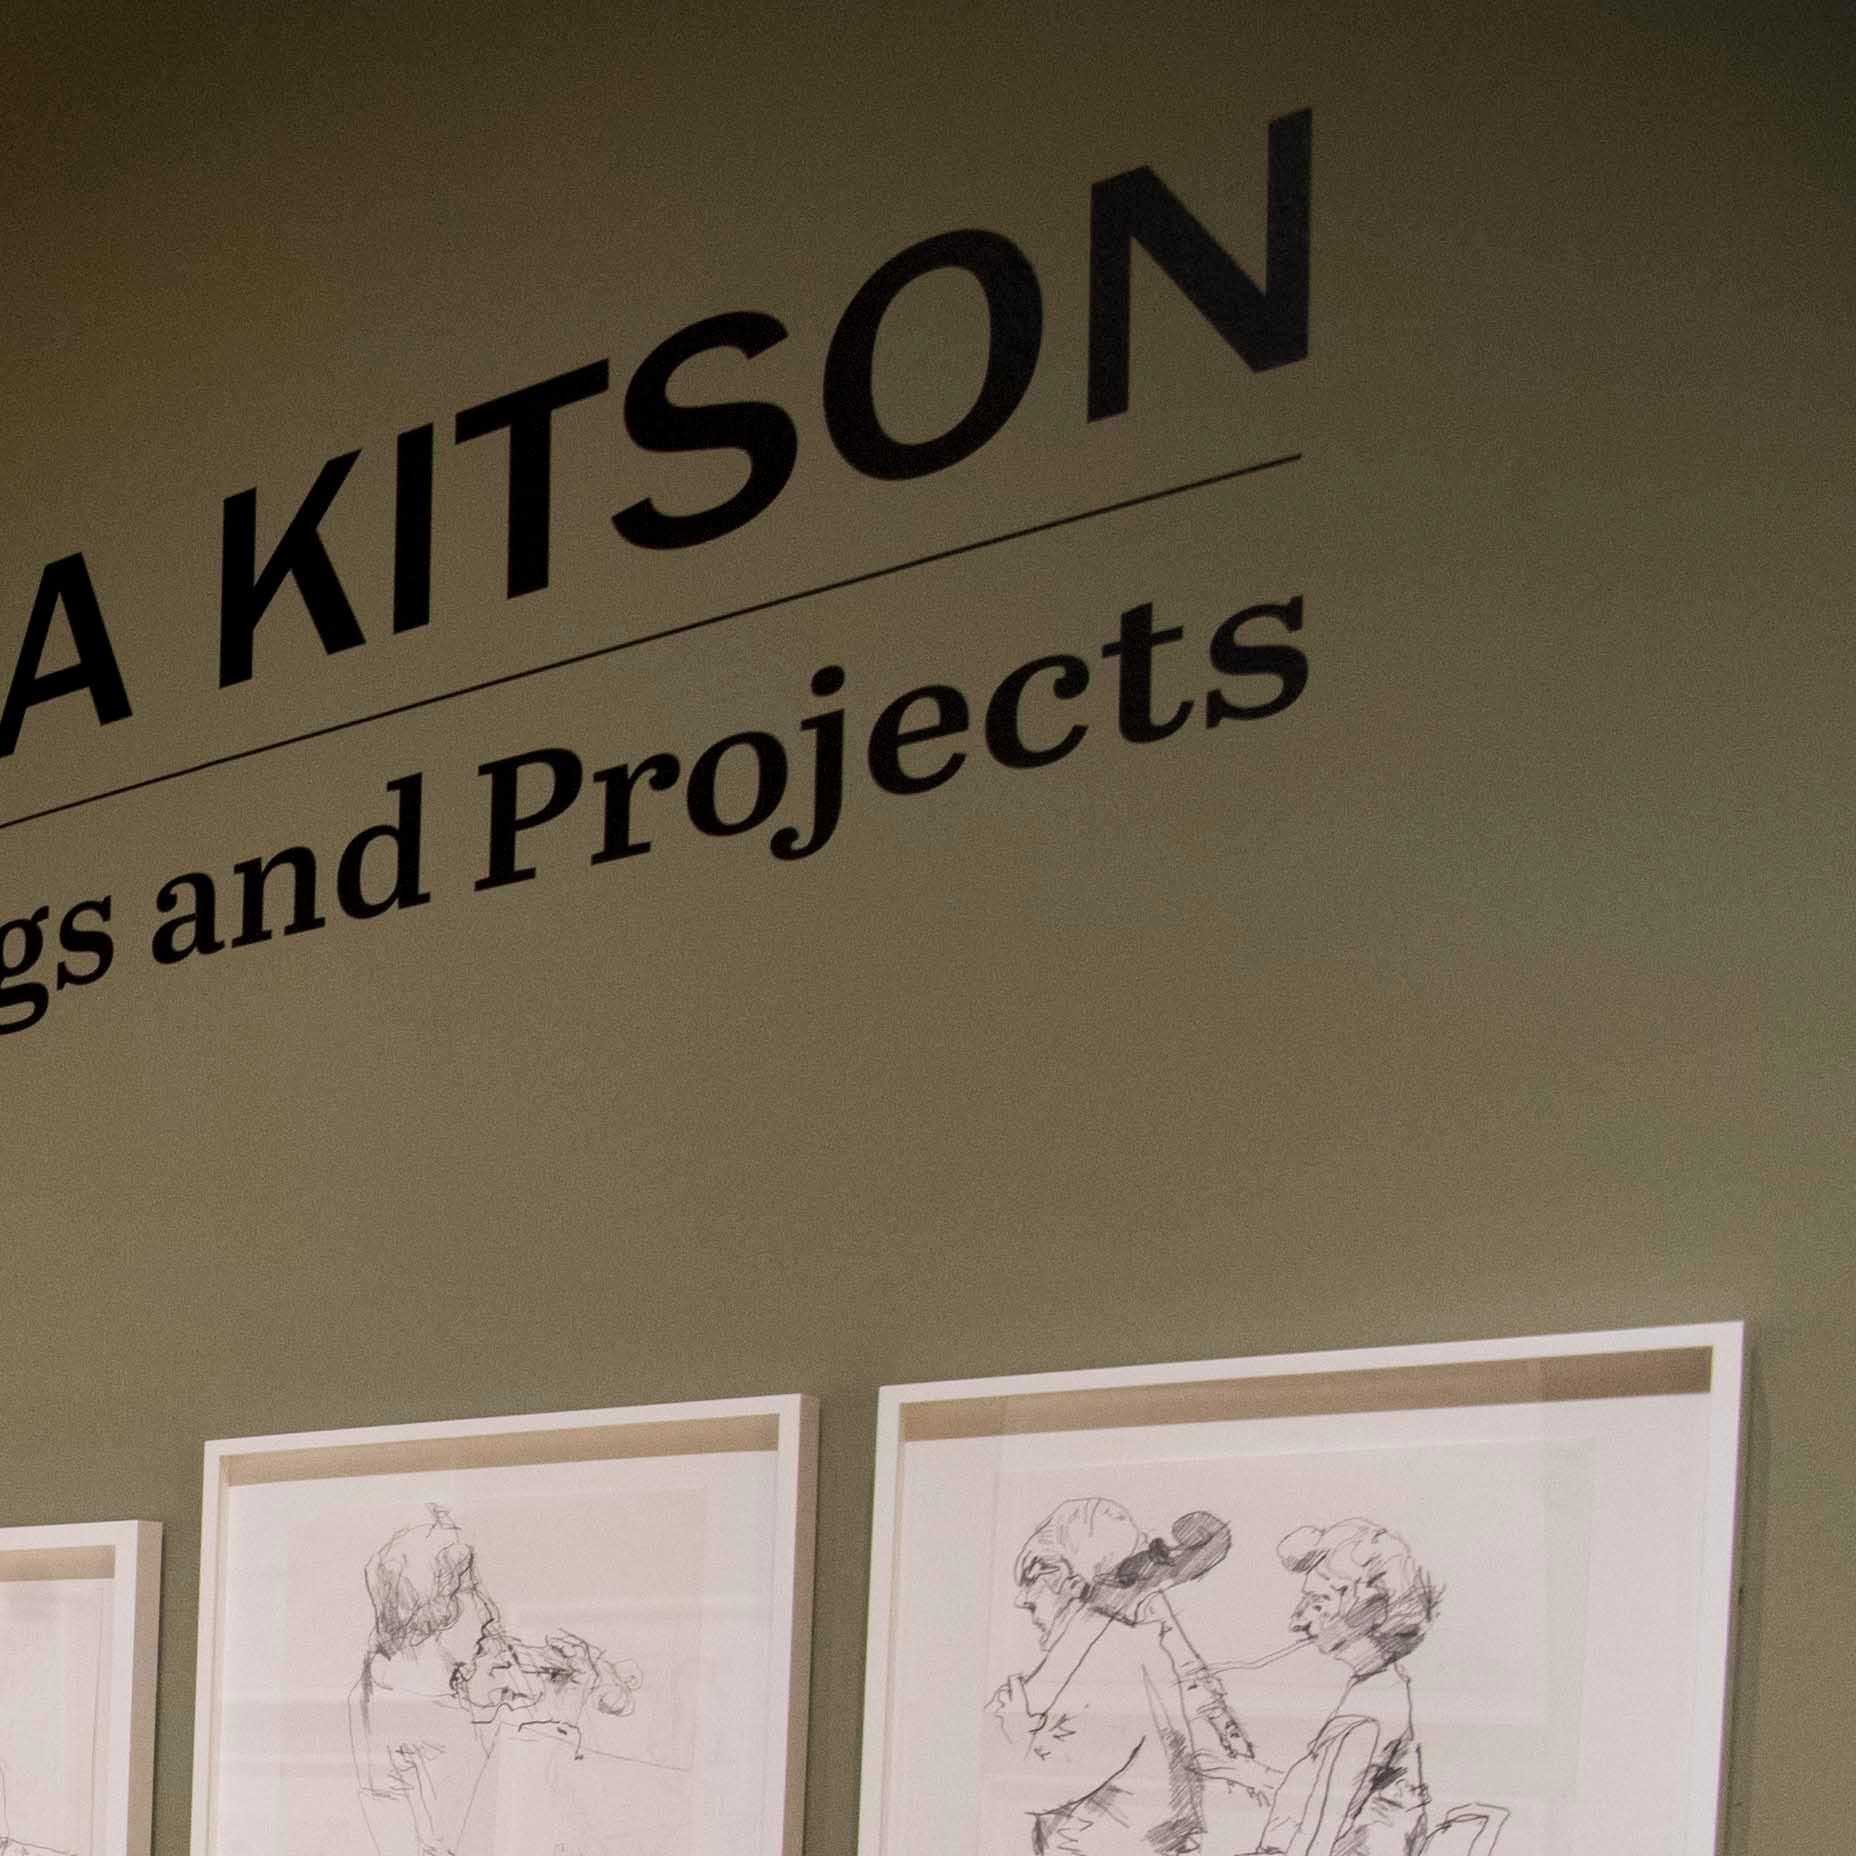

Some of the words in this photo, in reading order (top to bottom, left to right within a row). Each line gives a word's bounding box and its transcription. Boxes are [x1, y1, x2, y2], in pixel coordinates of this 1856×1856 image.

[217, 105, 1313, 689] KITSON
[147, 773, 431, 967] and
[473, 593, 1311, 895] Projects
